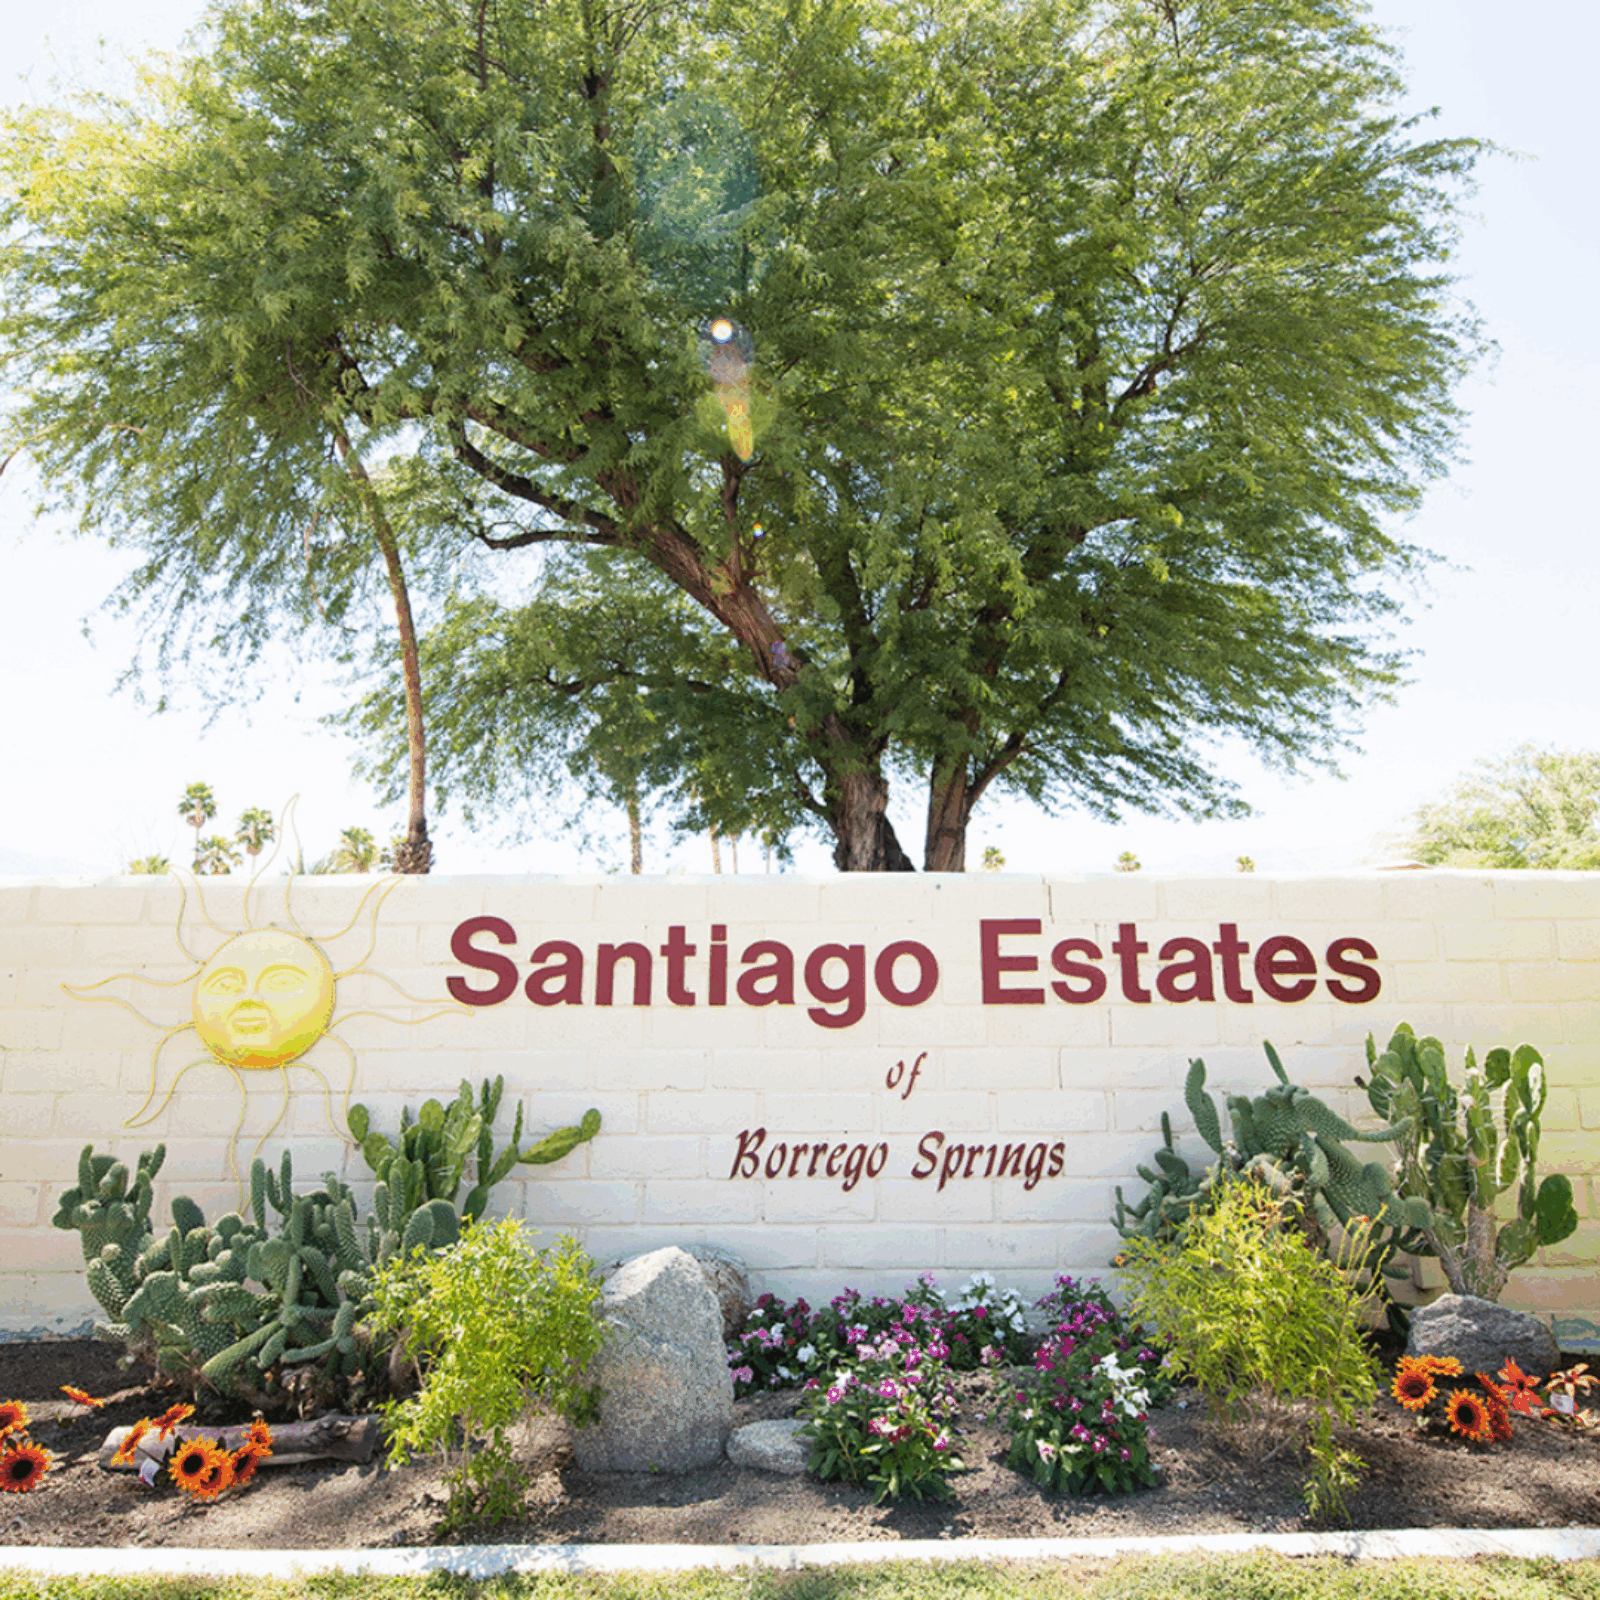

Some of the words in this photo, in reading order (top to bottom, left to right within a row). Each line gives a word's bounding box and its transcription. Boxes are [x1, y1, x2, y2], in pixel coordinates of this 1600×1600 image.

[446, 916, 938, 1028] Santiago
[981, 919, 1382, 1005] Estates
[886, 1052, 928, 1100] of
[729, 1127, 889, 1192] Borrego
[911, 1131, 1065, 1191] Springs
